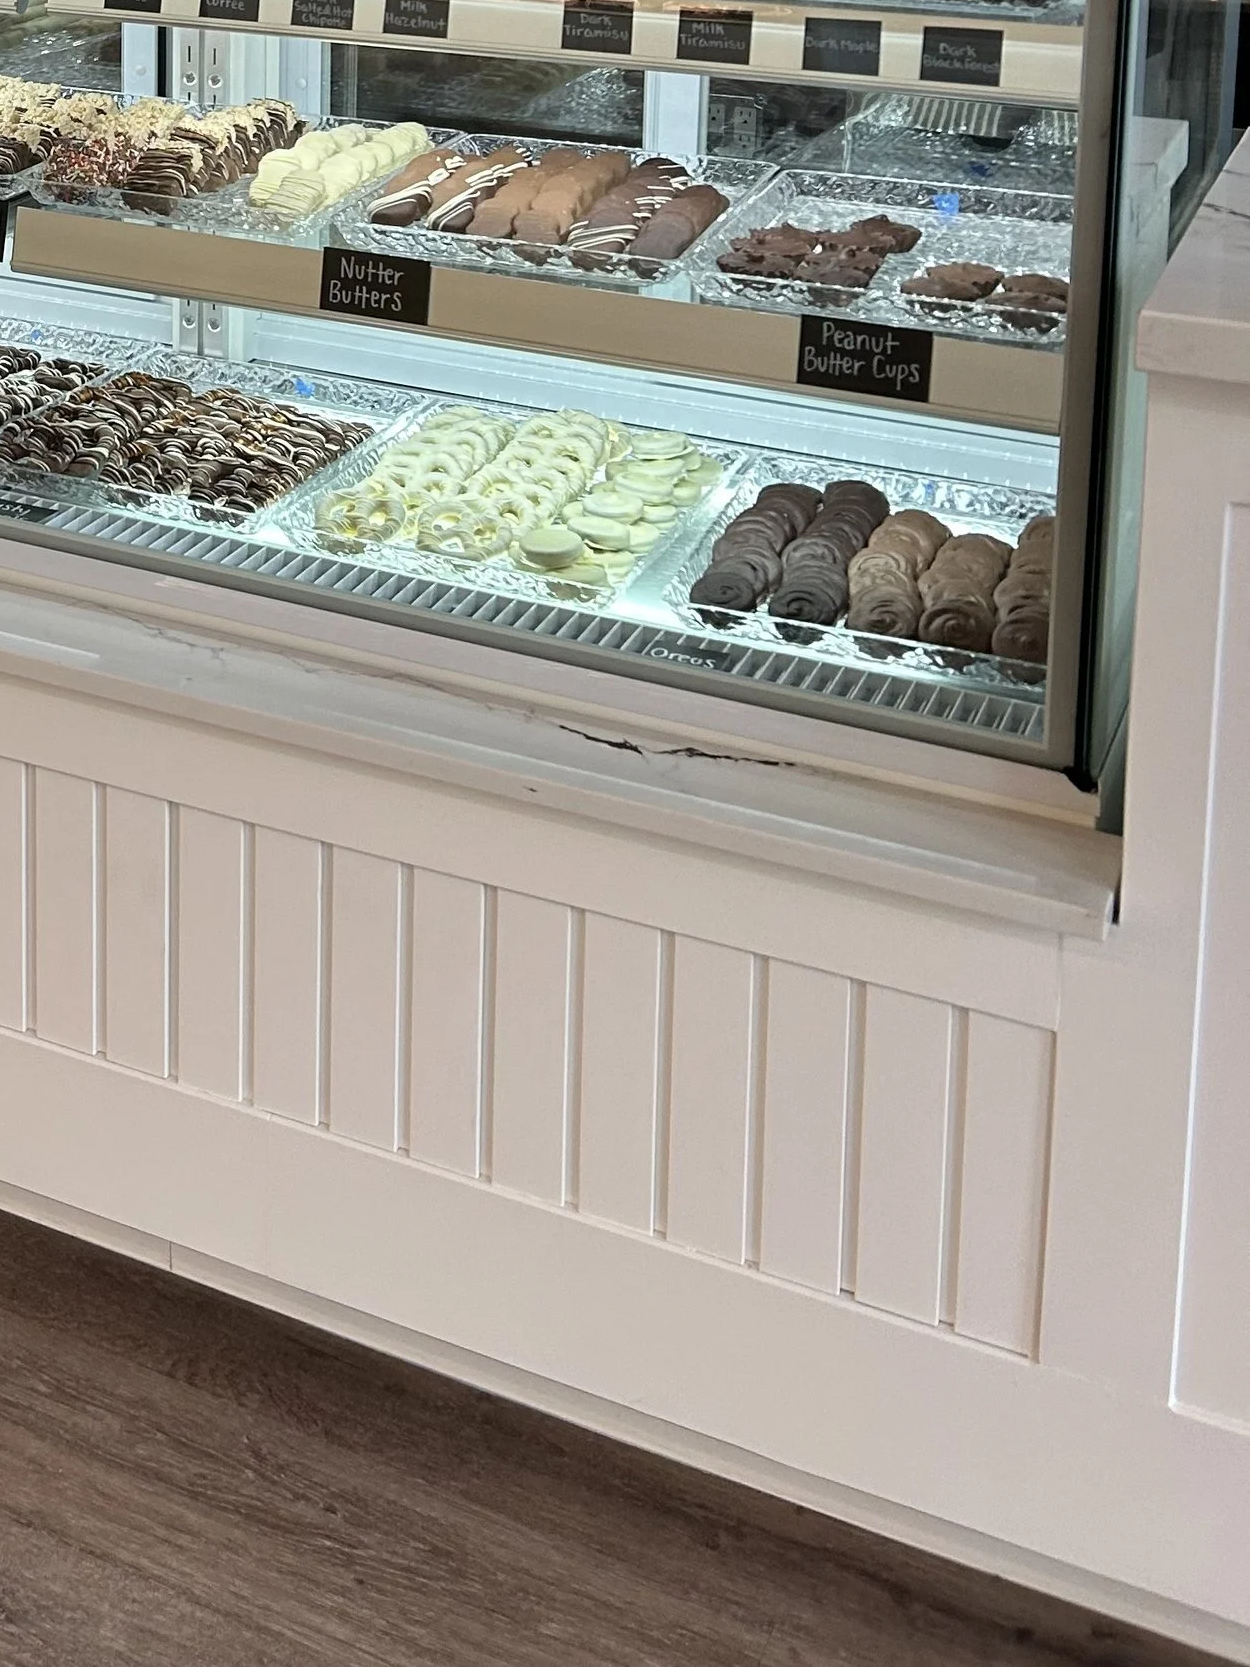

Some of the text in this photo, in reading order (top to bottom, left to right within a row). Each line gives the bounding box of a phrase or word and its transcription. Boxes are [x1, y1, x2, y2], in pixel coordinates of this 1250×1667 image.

[400, 0, 428, 13] Milk
[385, 12, 447, 31] Hazelnut
[580, 13, 612, 26] Dark
[692, 22, 725, 35] Milk
[563, 24, 629, 41] Tiramisu
[679, 34, 746, 51] Tiramisu
[938, 42, 977, 58] Dark
[340, 256, 405, 286] Nutter
[329, 279, 402, 312] Butters
[822, 321, 900, 354] Peanut
[803, 346, 920, 391] Butter Cups
[650, 647, 717, 669] Oreos
